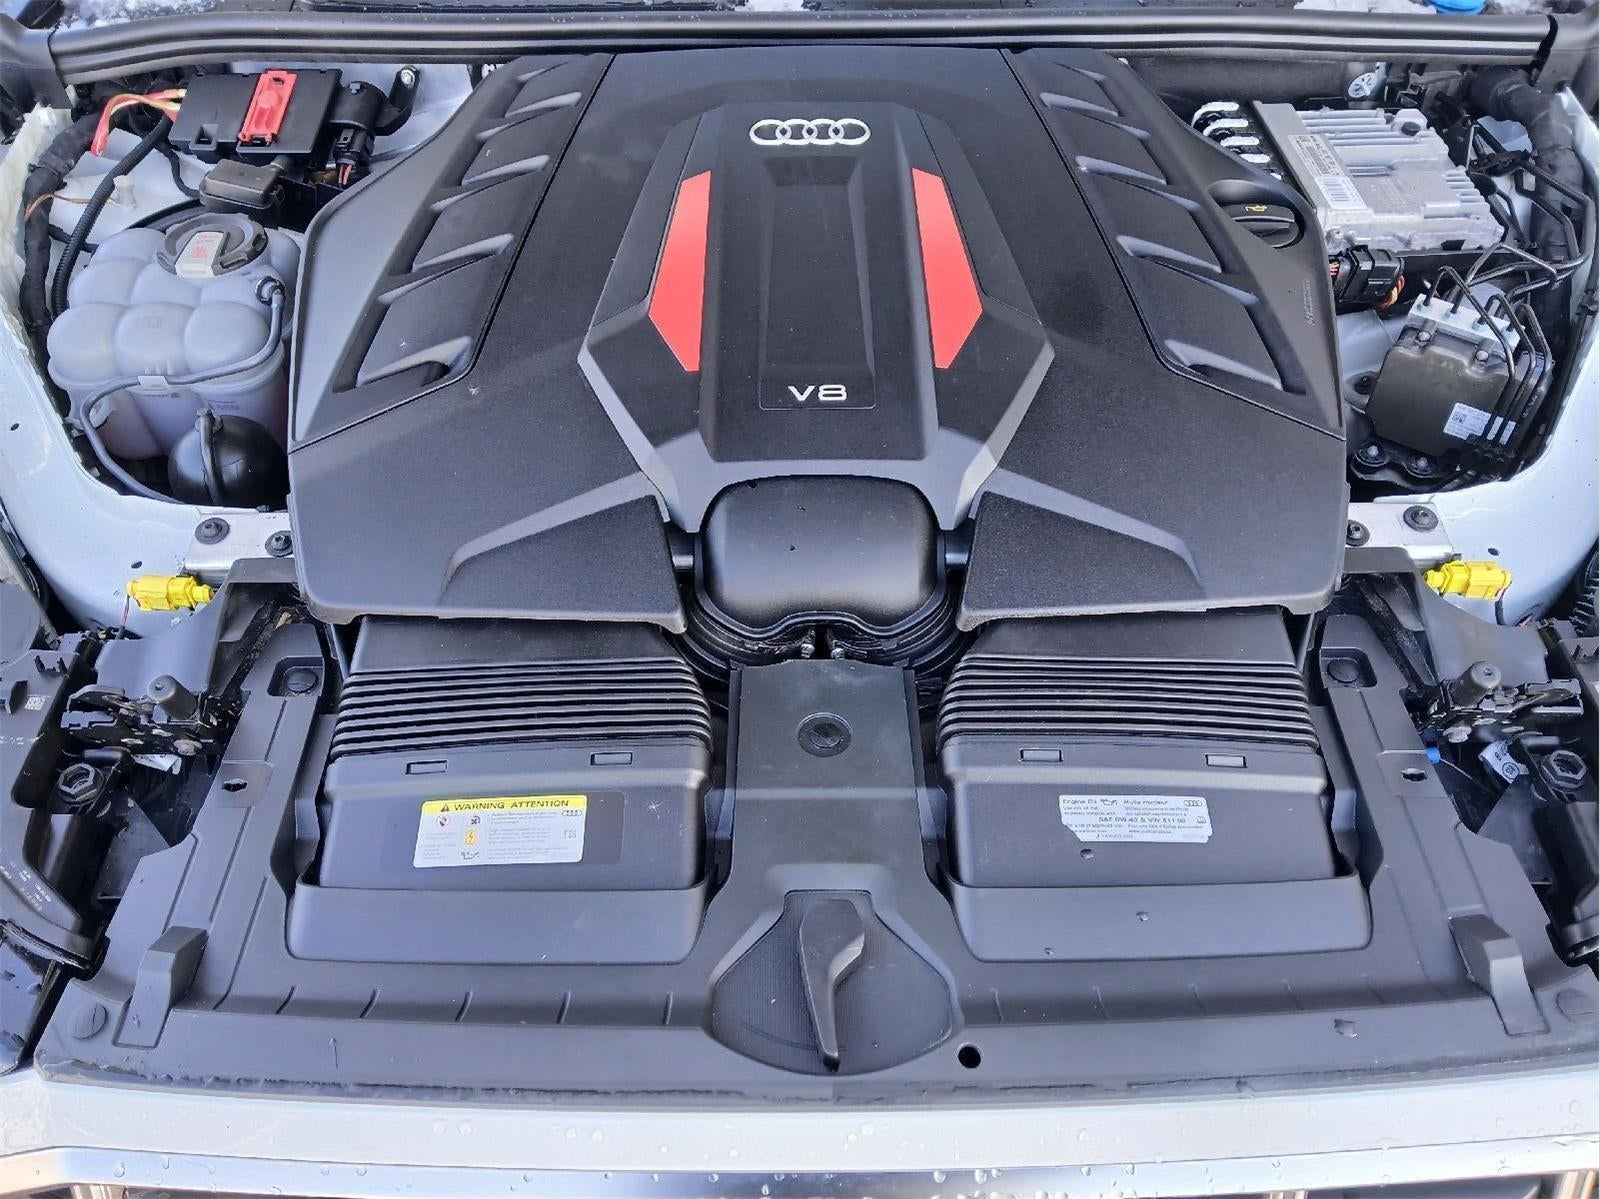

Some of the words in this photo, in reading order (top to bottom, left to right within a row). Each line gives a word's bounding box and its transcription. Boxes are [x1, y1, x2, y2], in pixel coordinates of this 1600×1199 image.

[787, 384, 847, 401] V8
[454, 802, 505, 811] WARNING
[510, 800, 569, 809] ATTENTION
